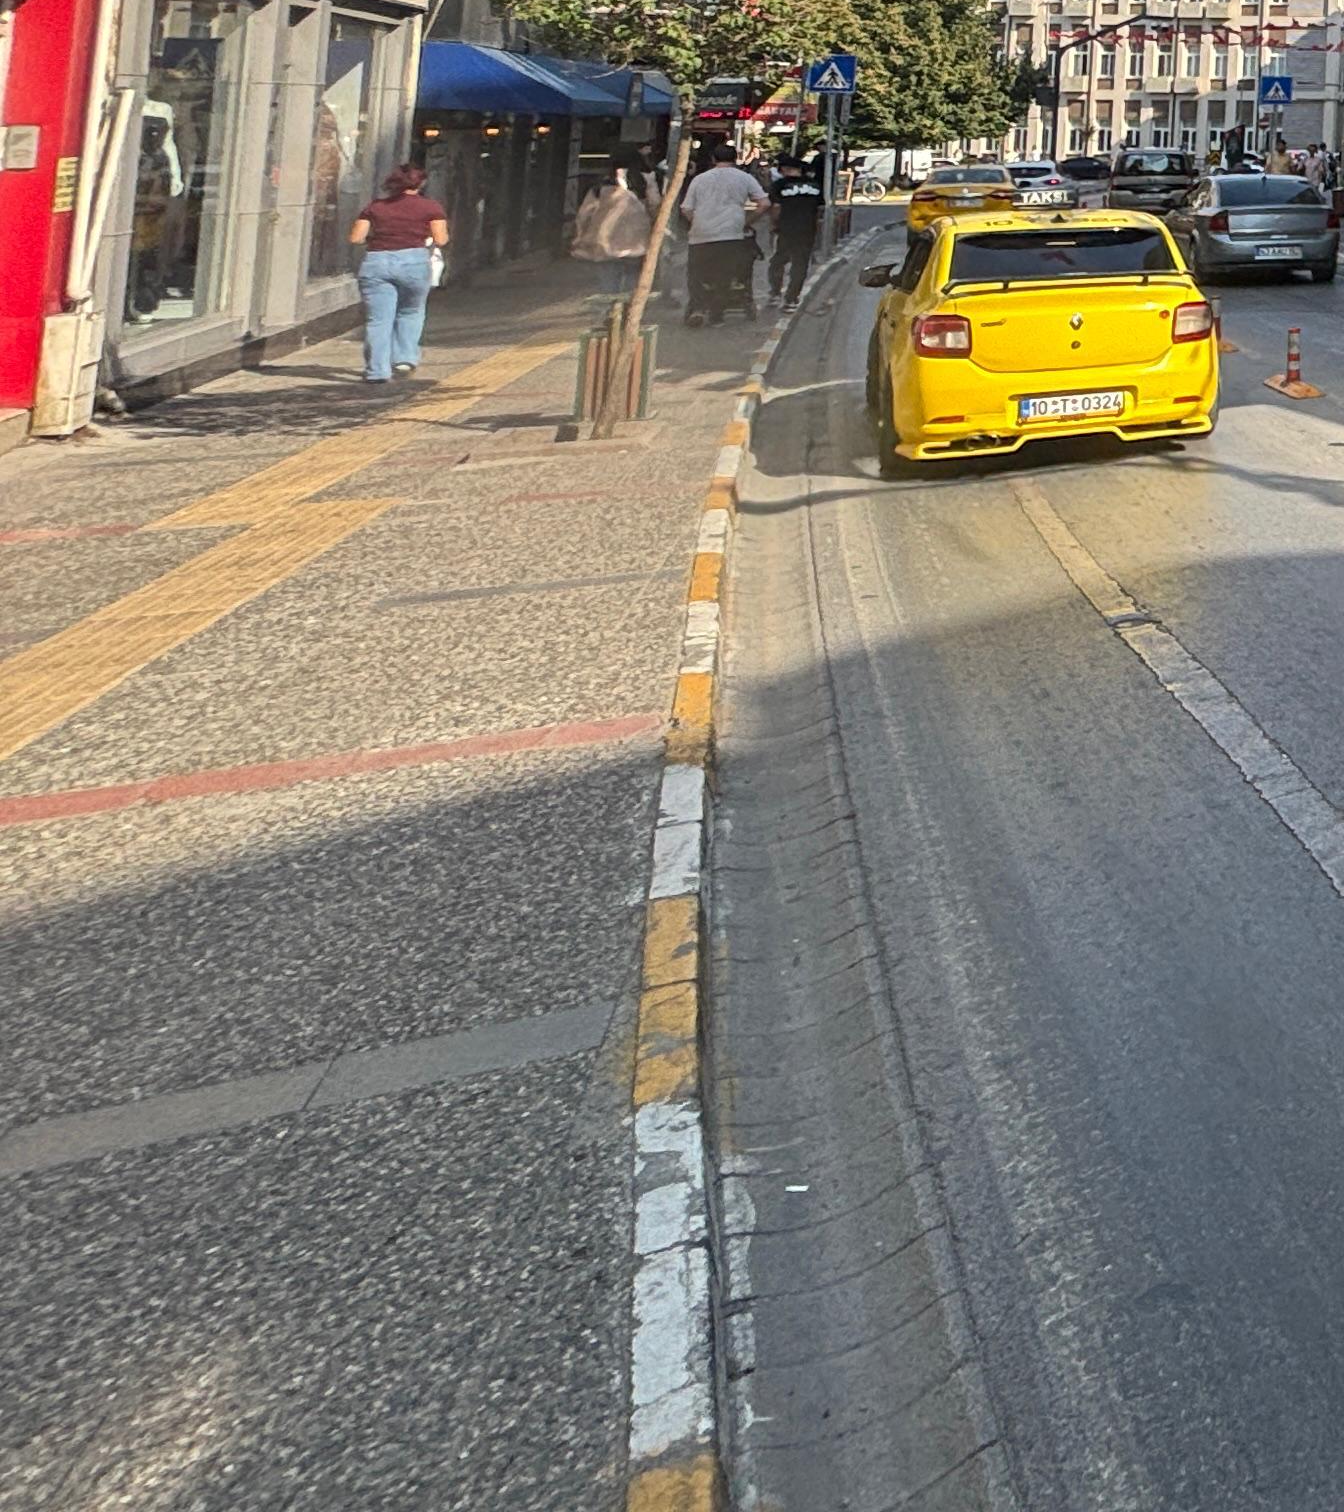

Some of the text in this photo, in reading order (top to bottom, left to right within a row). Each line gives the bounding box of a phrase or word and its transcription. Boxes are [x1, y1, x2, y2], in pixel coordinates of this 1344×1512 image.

[1031, 393, 1122, 416] 10 T 0324
